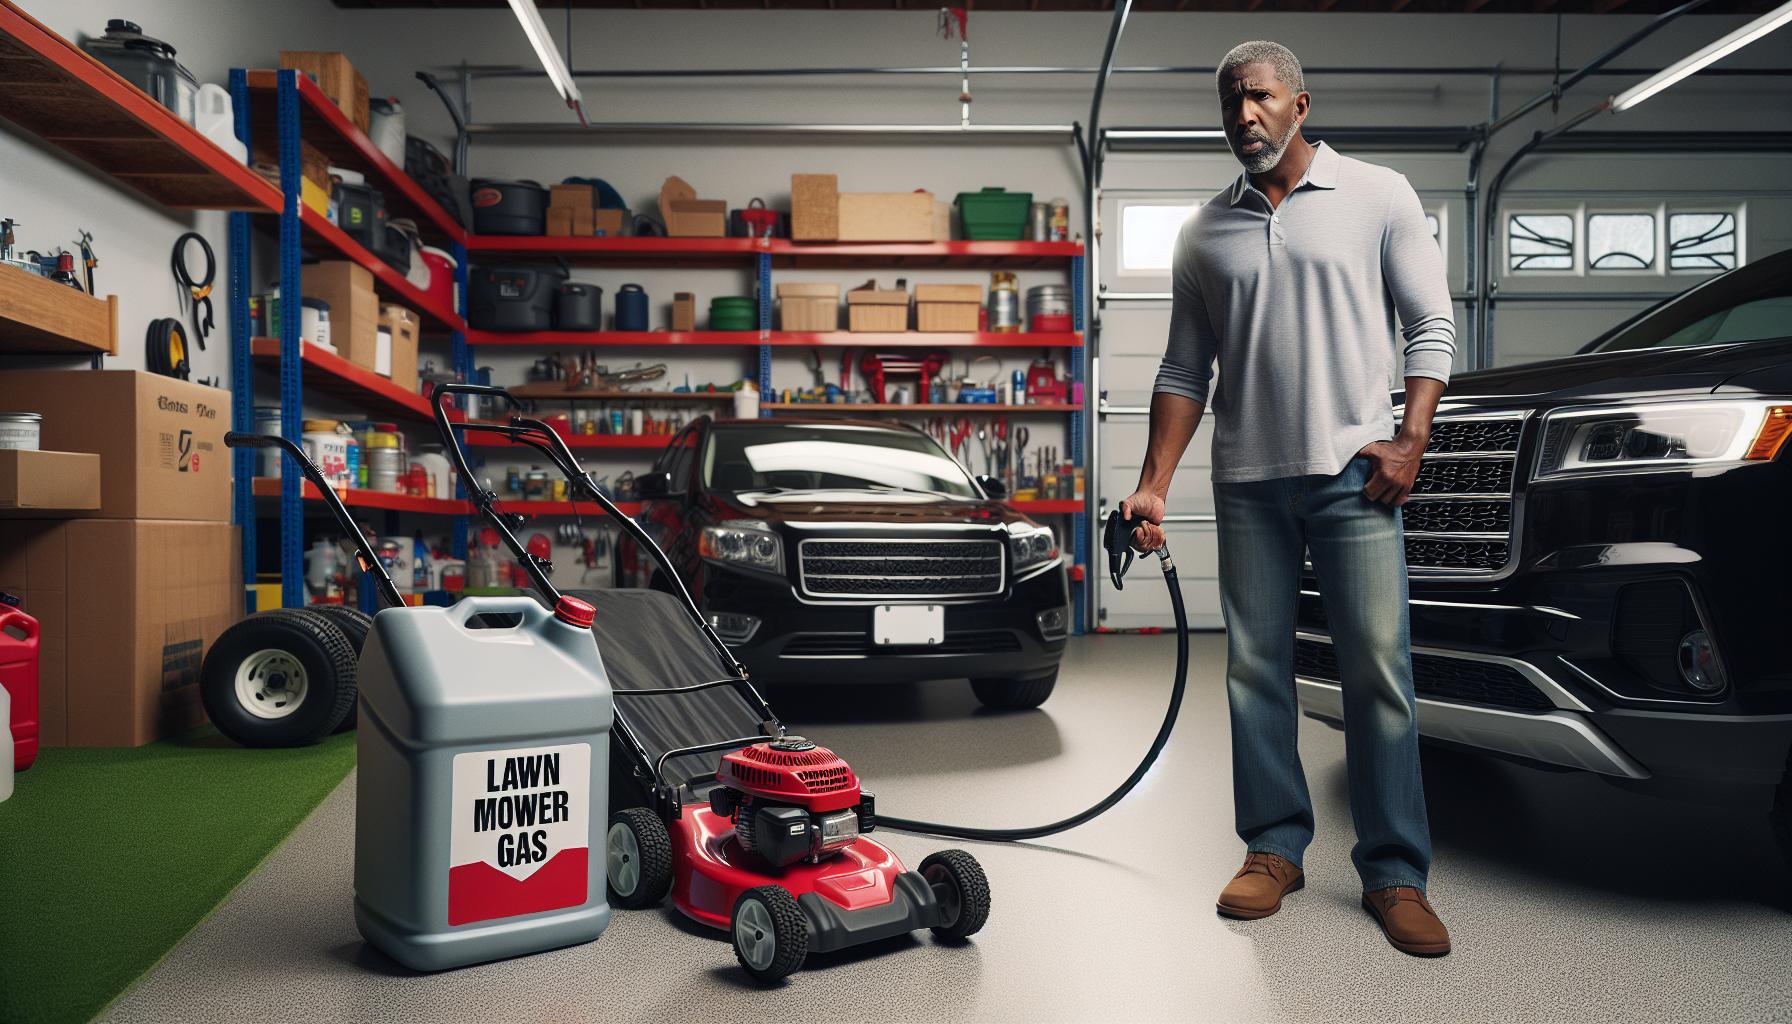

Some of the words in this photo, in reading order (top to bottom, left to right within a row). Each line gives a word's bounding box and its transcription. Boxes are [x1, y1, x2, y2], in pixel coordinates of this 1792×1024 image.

[487, 753, 560, 792] LAWN
[474, 791, 569, 832] MOWER
[497, 830, 547, 868] GAS
